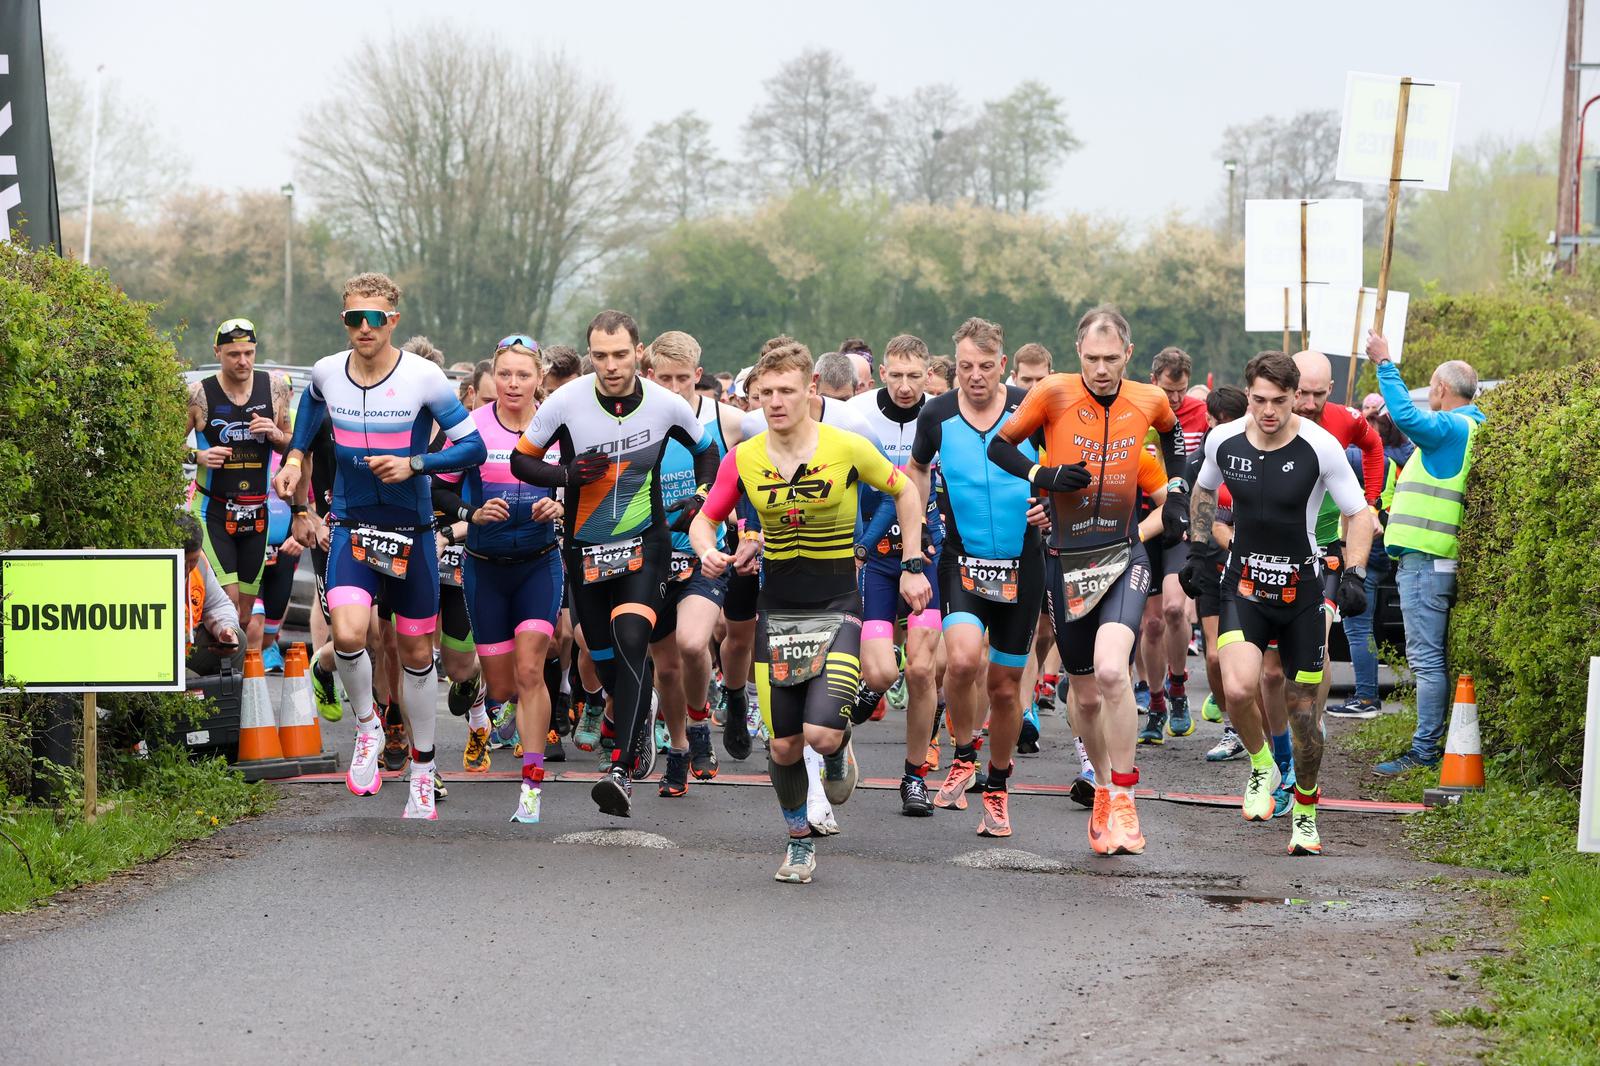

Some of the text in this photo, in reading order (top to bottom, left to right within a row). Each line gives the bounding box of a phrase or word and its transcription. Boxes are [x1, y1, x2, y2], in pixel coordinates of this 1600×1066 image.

[1073, 433, 1136, 452] WESTERN
[1081, 450, 1129, 463] TEMPO
[1227, 454, 1253, 472] TB
[1222, 469, 1257, 480] TRIATHLON
[361, 536, 399, 555] F148
[594, 550, 632, 566] F095
[1248, 551, 1291, 565] ZONE3
[969, 567, 1008, 582] F094
[1250, 568, 1287, 586] F028
[11, 603, 167, 631] DISMOUNT
[783, 644, 820, 661] F042
